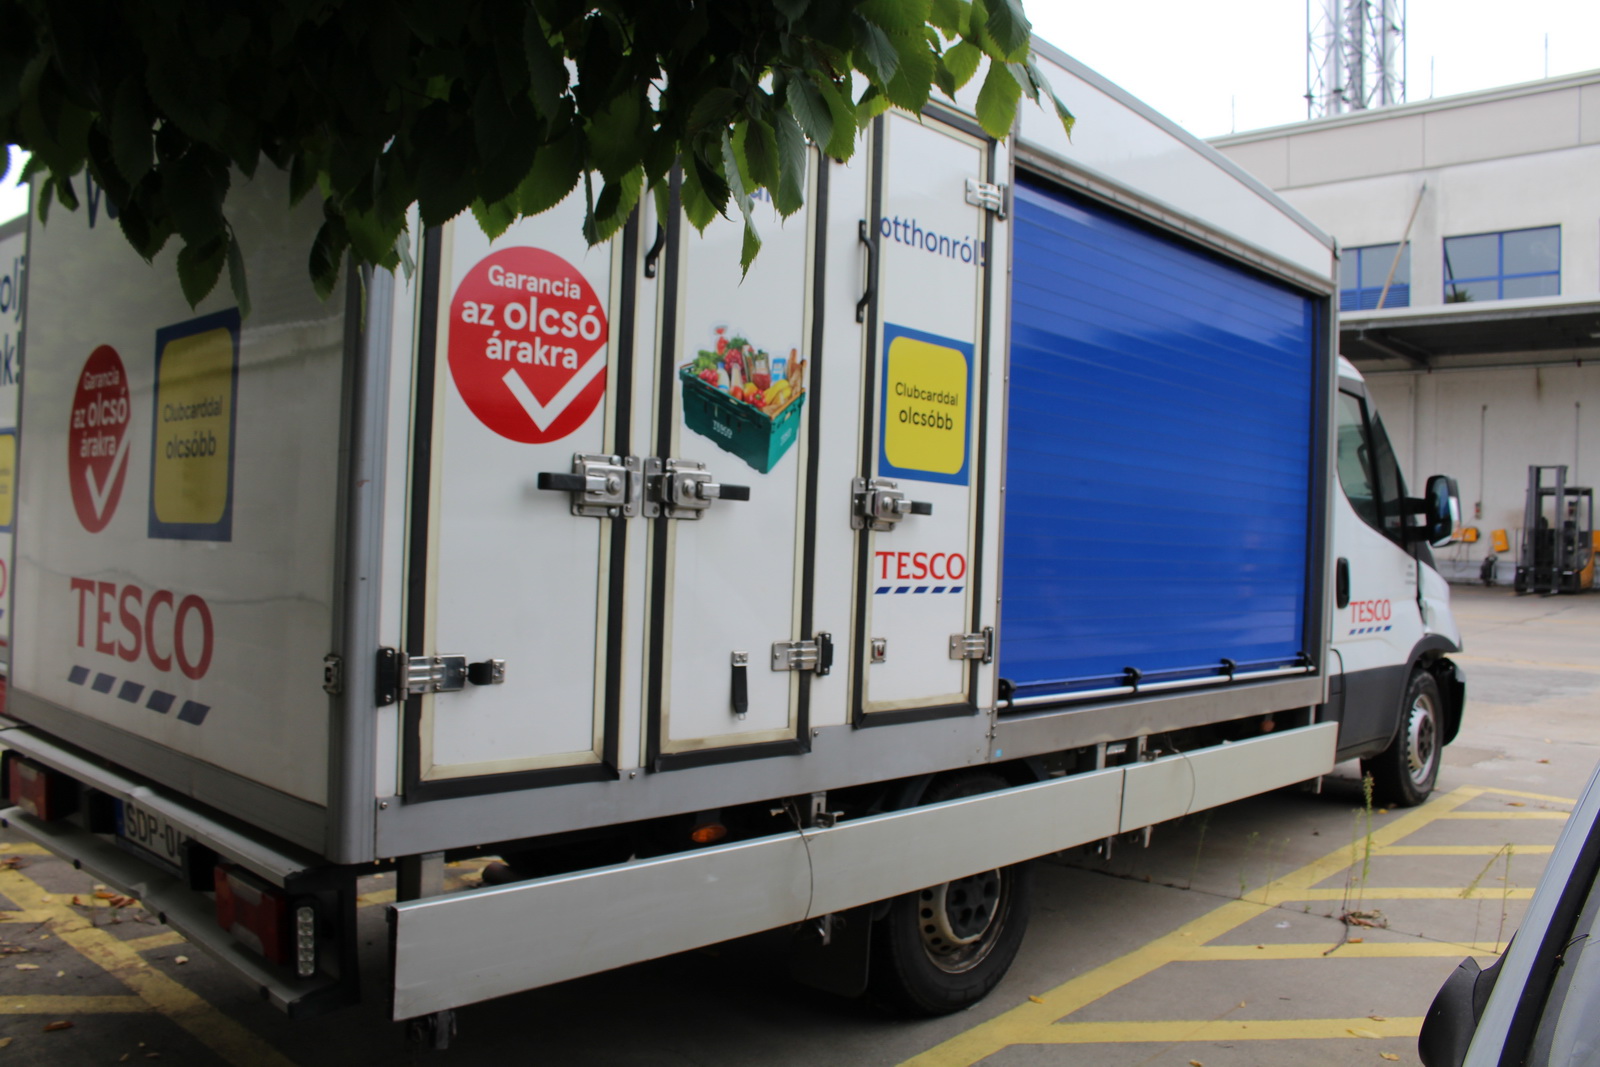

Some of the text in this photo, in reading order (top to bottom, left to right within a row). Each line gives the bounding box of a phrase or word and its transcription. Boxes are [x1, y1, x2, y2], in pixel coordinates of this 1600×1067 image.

[880, 216, 986, 267] otthonról!
[487, 265, 581, 300] Garancia
[461, 296, 601, 341] az olcsó
[485, 330, 578, 370] árakra
[83, 367, 120, 391] Garancia
[73, 387, 128, 429] az olcsó
[895, 381, 959, 407] Clubcarddal
[163, 395, 223, 423] Clubcarddal
[899, 408, 954, 431] olcsóbb
[79, 430, 117, 458] árakra
[166, 430, 216, 460] olcsóbb
[875, 551, 967, 580] TESCO
[1349, 599, 1391, 623] TESCO
[70, 577, 214, 681] TESCO
